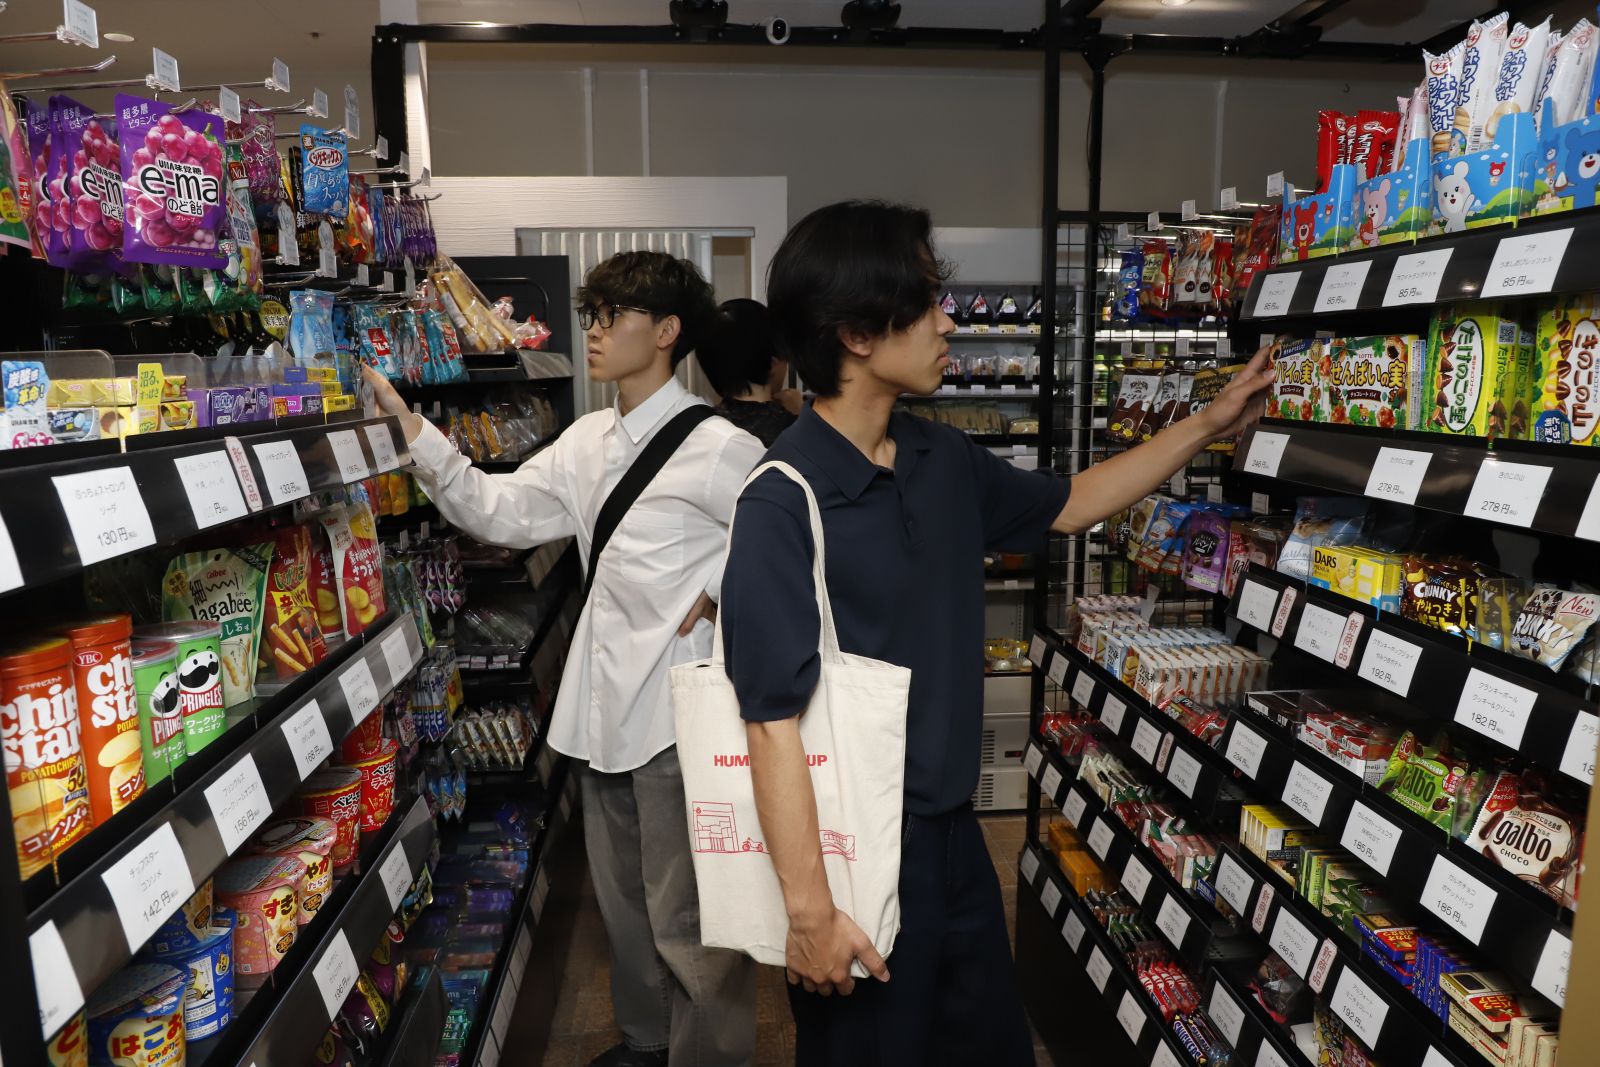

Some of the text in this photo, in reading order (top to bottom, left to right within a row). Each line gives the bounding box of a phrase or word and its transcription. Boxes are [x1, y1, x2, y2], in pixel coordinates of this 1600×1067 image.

[122, 104, 149, 121] 超多層
[129, 116, 158, 129] ビタミンC
[141, 167, 219, 205] e-ma
[167, 198, 204, 216] のど飴
[1502, 275, 1527, 288] 85円
[1326, 295, 1342, 305] 85円
[1398, 287, 1418, 298] 85円
[1358, 352, 1373, 360] LOTTE
[1330, 359, 1407, 388] せんぱいの実
[1449, 325, 1476, 425] たけのこの里
[1572, 333, 1598, 428] きのこの山
[1377, 482, 1401, 495] 278円
[1481, 500, 1511, 516] 278円
[97, 526, 129, 547] 130円
[1314, 550, 1337, 569] DARS
[1413, 581, 1457, 602] CRUNKY
[1416, 599, 1453, 616] やみつき
[1561, 594, 1595, 616] New
[1512, 612, 1575, 649] RUNKY
[79, 654, 100, 665] YBC
[1371, 667, 1393, 684] 192円
[181, 690, 223, 713] PRINGLES
[184, 712, 226, 728] ワークリーム
[1471, 711, 1499, 732] 182円
[714, 754, 750, 767] HUM
[1365, 763, 1381, 771] meiji
[1290, 793, 1309, 812] 252円
[233, 808, 256, 834] 156円
[1353, 839, 1373, 859] 185円
[1492, 820, 1552, 862] galbo
[129, 850, 160, 880] チップスター
[1500, 848, 1530, 867] CHOCO
[140, 870, 163, 892] コンソメ
[143, 890, 171, 922] 142円
[1436, 900, 1462, 924] 185円
[1278, 940, 1295, 961] 246円
[1342, 1004, 1362, 1028] 192円
